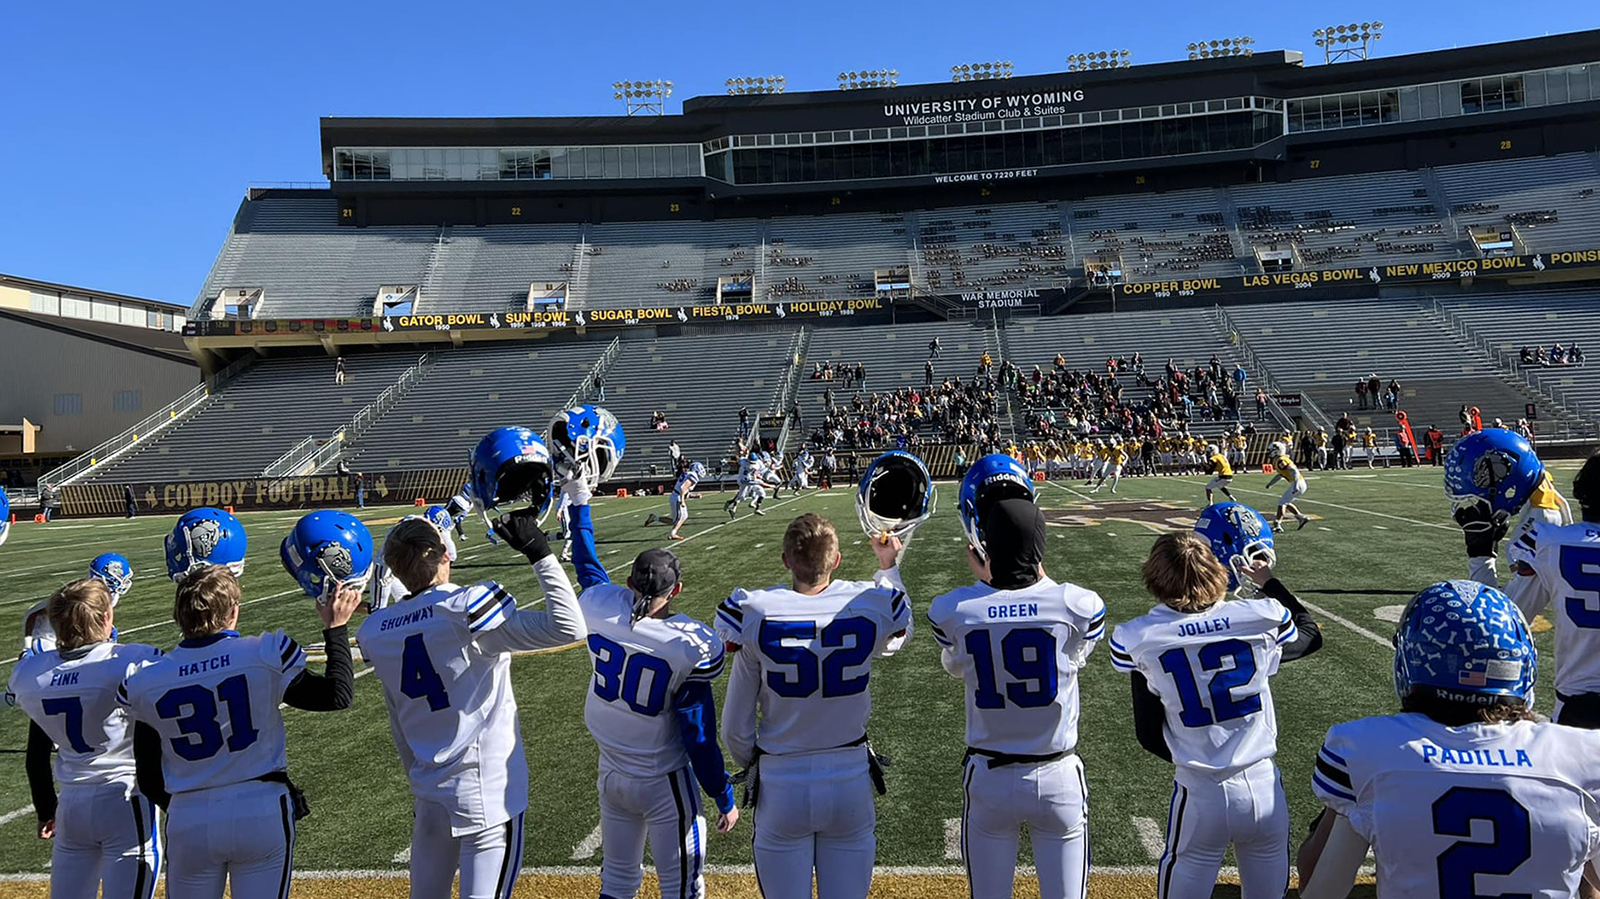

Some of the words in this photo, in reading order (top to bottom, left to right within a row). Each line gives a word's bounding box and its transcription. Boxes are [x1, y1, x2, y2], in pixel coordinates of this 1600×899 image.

[884, 99, 977, 117] UNIVERSITY
[981, 97, 1002, 109] OF
[1006, 90, 1084, 108] WYOMING
[903, 114, 952, 126] Wildcatter
[954, 111, 995, 122] Stadium
[998, 108, 1021, 119] Club
[1024, 107, 1031, 117] &
[1033, 105, 1066, 116] Suites
[1310, 160, 1320, 169] 27
[935, 173, 979, 184] WELCOME
[981, 172, 993, 180] TO
[994, 171, 1014, 179] 7220
[1015, 169, 1038, 177] FEET
[343, 209, 352, 217] 21
[511, 207, 521, 215] 22
[1386, 264, 1419, 277] NEW
[1422, 260, 1478, 274] MEXICO
[1482, 257, 1526, 270] BOWL
[1551, 250, 1600, 265] POINS
[1123, 281, 1179, 294] COPPER
[1182, 278, 1221, 291] BOWL
[1243, 275, 1270, 287] LAS
[1273, 271, 1319, 284] VEGAS
[1323, 268, 1363, 281] BOWL
[961, 293, 984, 301] WAR
[987, 290, 1040, 300] MEMORIAL
[978, 299, 1022, 308] STADIUM
[591, 309, 633, 321] SUGAR
[638, 308, 672, 319] BOWL
[693, 305, 733, 316] FIESTA
[736, 304, 771, 315] BOWL
[790, 301, 844, 313] HOLIDAY
[848, 299, 882, 310] BOWL
[400, 316, 443, 327] GATOR
[448, 314, 484, 325] BOWL
[505, 313, 530, 323] SUN
[535, 311, 570, 322] BOWL
[985, 473, 1025, 486] Riddell
[164, 481, 248, 507] COWBOY
[255, 476, 369, 505] FOOTBAL
[380, 604, 433, 631] SHUMWAY
[988, 603, 1039, 619] GREEN
[1178, 617, 1231, 638] JOLLEY
[178, 654, 231, 677] HATCH
[758, 615, 877, 698] 52
[401, 633, 451, 712] 4
[587, 633, 673, 717] 30
[965, 628, 1058, 709] 19
[50, 672, 79, 687] FINK
[1158, 638, 1262, 728] 12
[41, 696, 95, 754] 7
[155, 674, 260, 762] 31
[1422, 744, 1533, 768] PADILLA
[1431, 786, 1532, 899] 2
